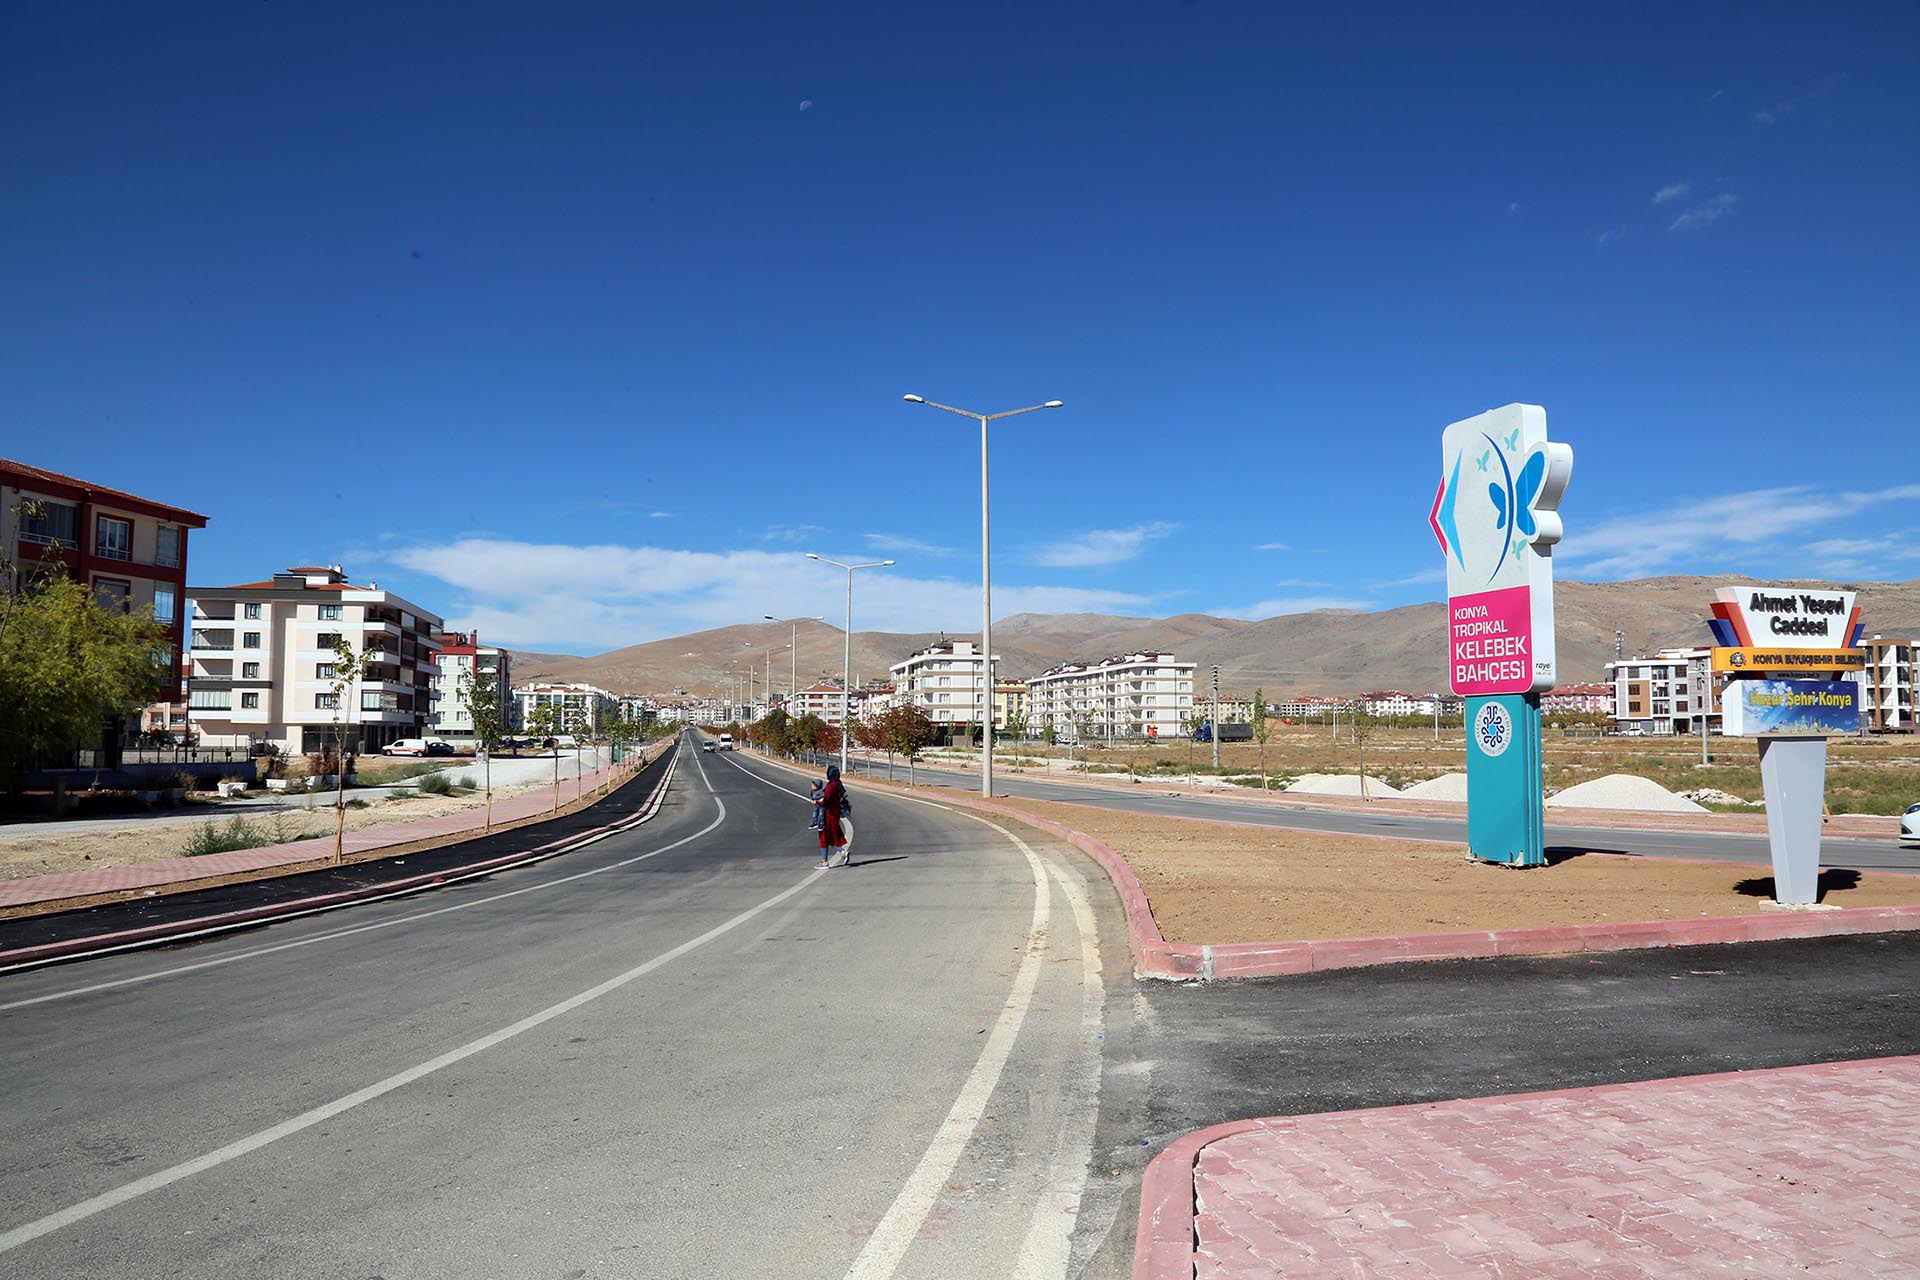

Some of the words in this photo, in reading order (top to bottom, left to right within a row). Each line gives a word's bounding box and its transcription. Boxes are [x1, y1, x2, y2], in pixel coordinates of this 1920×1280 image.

[1454, 605, 1488, 620] KONYA
[1750, 592, 1797, 613] Ahmet
[1799, 594, 1845, 615] Yesevi
[1453, 619, 1508, 638] TROPİKAL
[1770, 615, 1828, 636] Caddesi
[1455, 635, 1527, 660] KELEBEK
[1753, 654, 1783, 665] KONYA
[1456, 660, 1525, 684] BAHÇESİ
[1750, 691, 1784, 706] Huzur
[1786, 690, 1816, 710] Şehri
[1819, 691, 1852, 710] Konya
